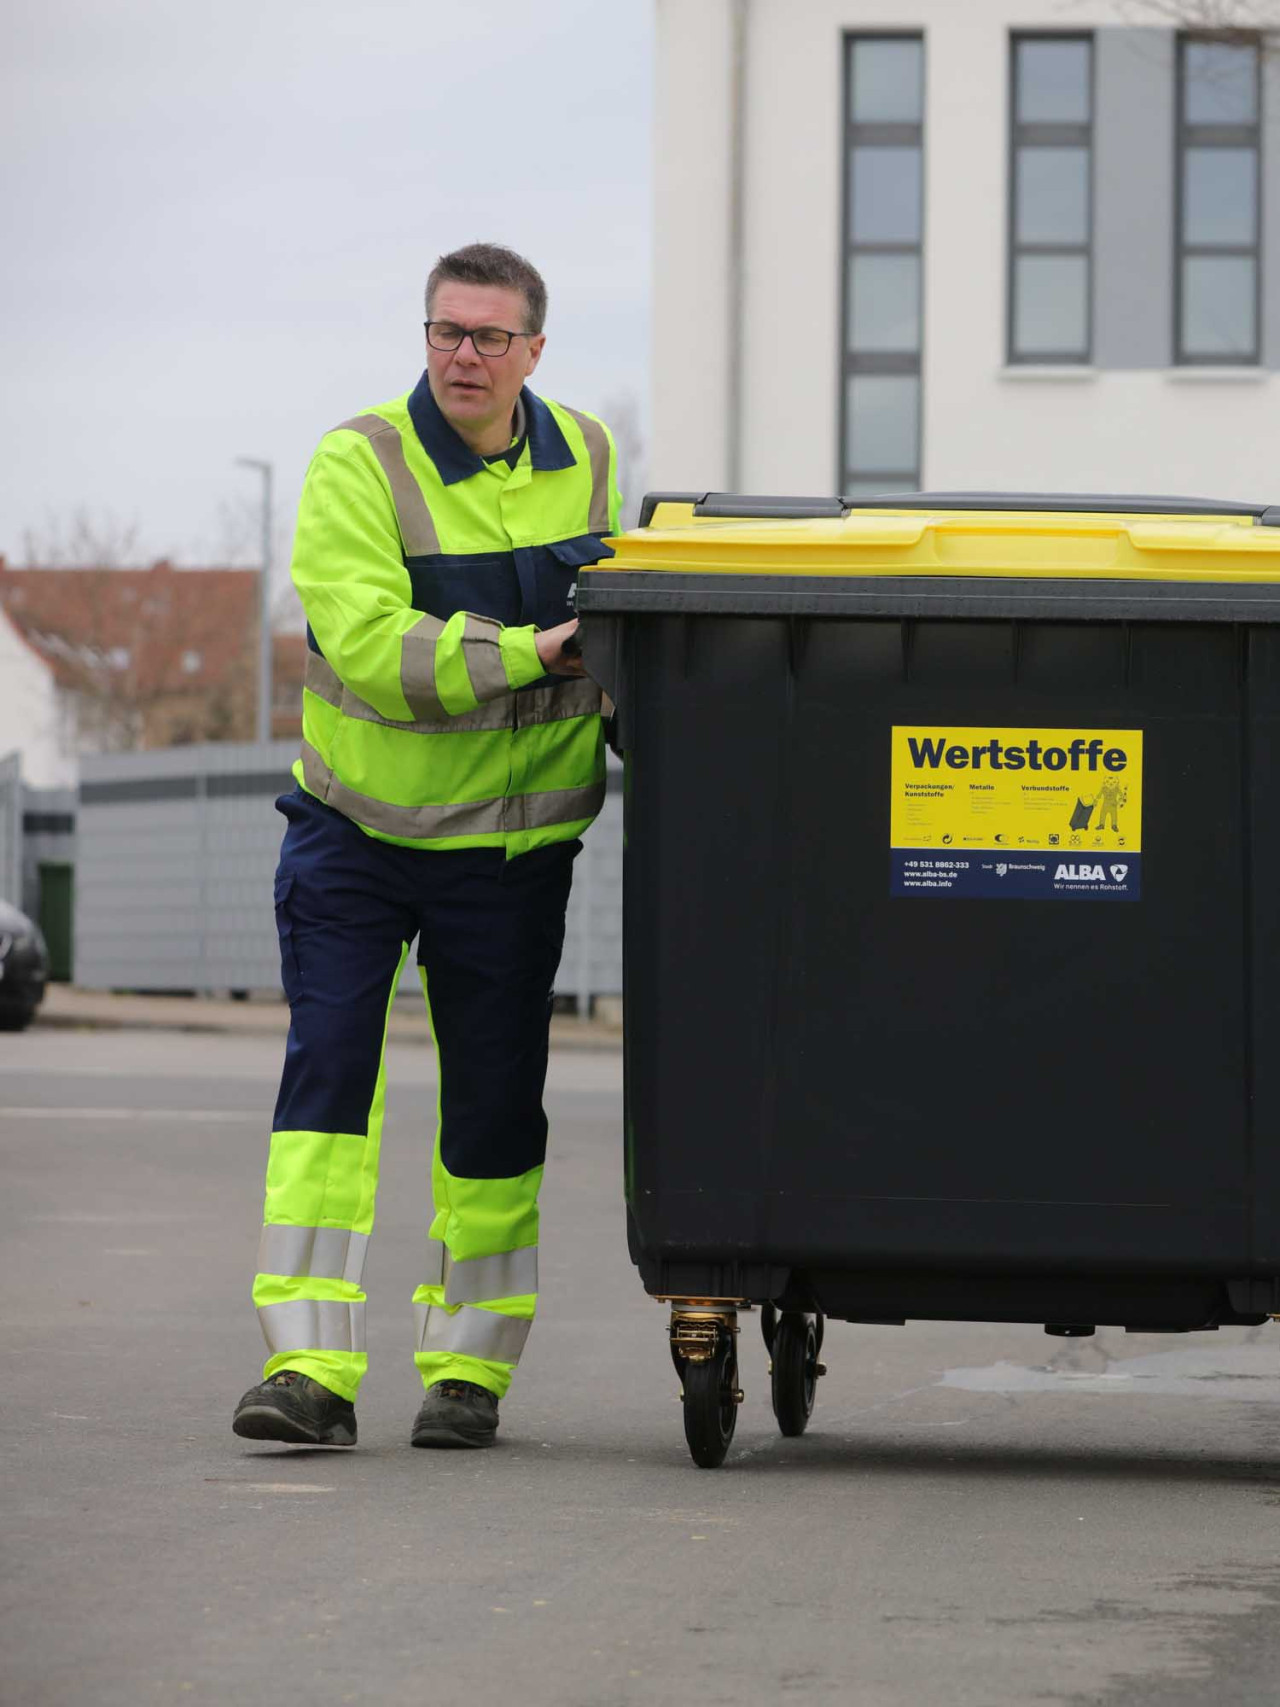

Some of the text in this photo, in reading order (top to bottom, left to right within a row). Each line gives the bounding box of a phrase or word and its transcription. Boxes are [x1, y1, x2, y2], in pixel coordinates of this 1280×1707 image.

[907, 737, 1127, 772] Wertstoffe
[1008, 863, 1046, 872] Braunschweig
[1054, 864, 1106, 881] ALBA
